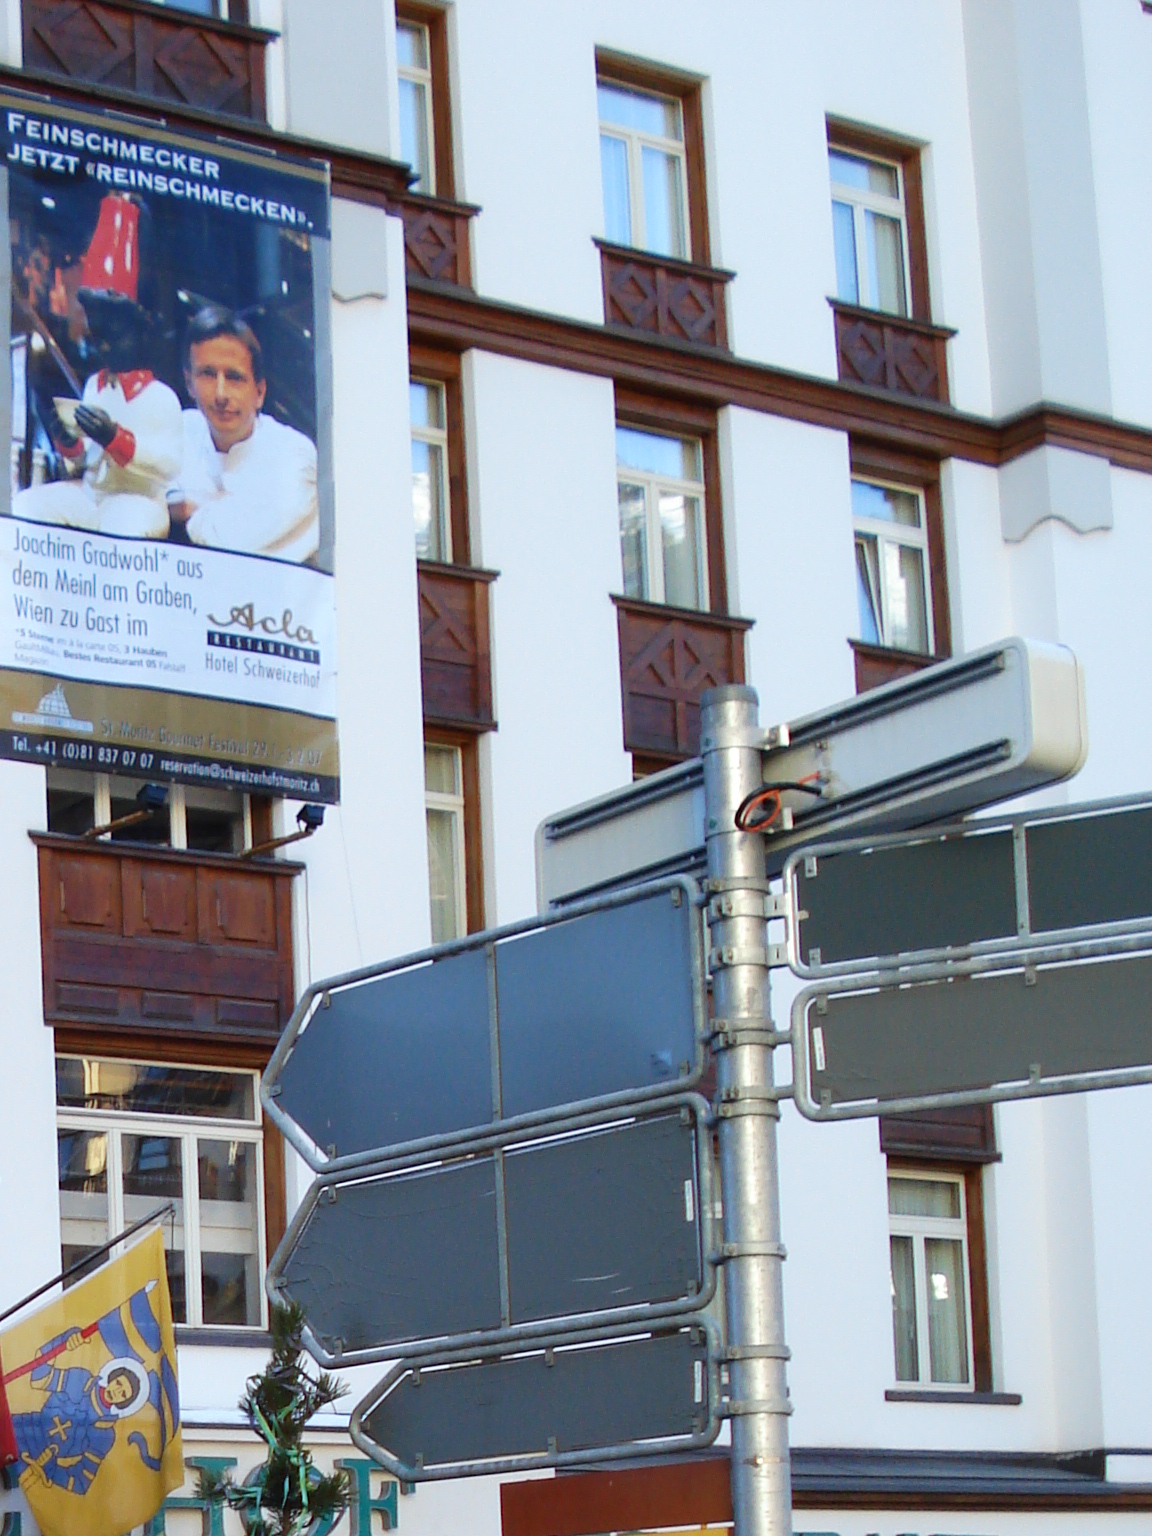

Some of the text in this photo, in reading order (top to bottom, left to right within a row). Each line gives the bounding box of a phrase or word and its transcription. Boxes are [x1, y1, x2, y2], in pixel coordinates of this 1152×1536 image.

[7, 112, 220, 179] FEINSCHMECKER
[7, 143, 80, 175] JETZT
[13, 527, 76, 561] Joachim
[176, 559, 204, 579] aus
[12, 559, 198, 615] dem Meinl am Graben,
[13, 593, 149, 637] Wien zu Gast im
[207, 602, 319, 644] Acla
[93, 653, 144, 667] Restaurant
[214, 633, 315, 661] RESTAURANT
[205, 652, 321, 689] Hotel Schweizerhof
[12, 736, 30, 752] Tel.
[36, 740, 56, 756] +41
[63, 743, 92, 759] (0)81
[98, 747, 118, 763] 837
[123, 750, 136, 766] 07
[140, 753, 153, 769] 07
